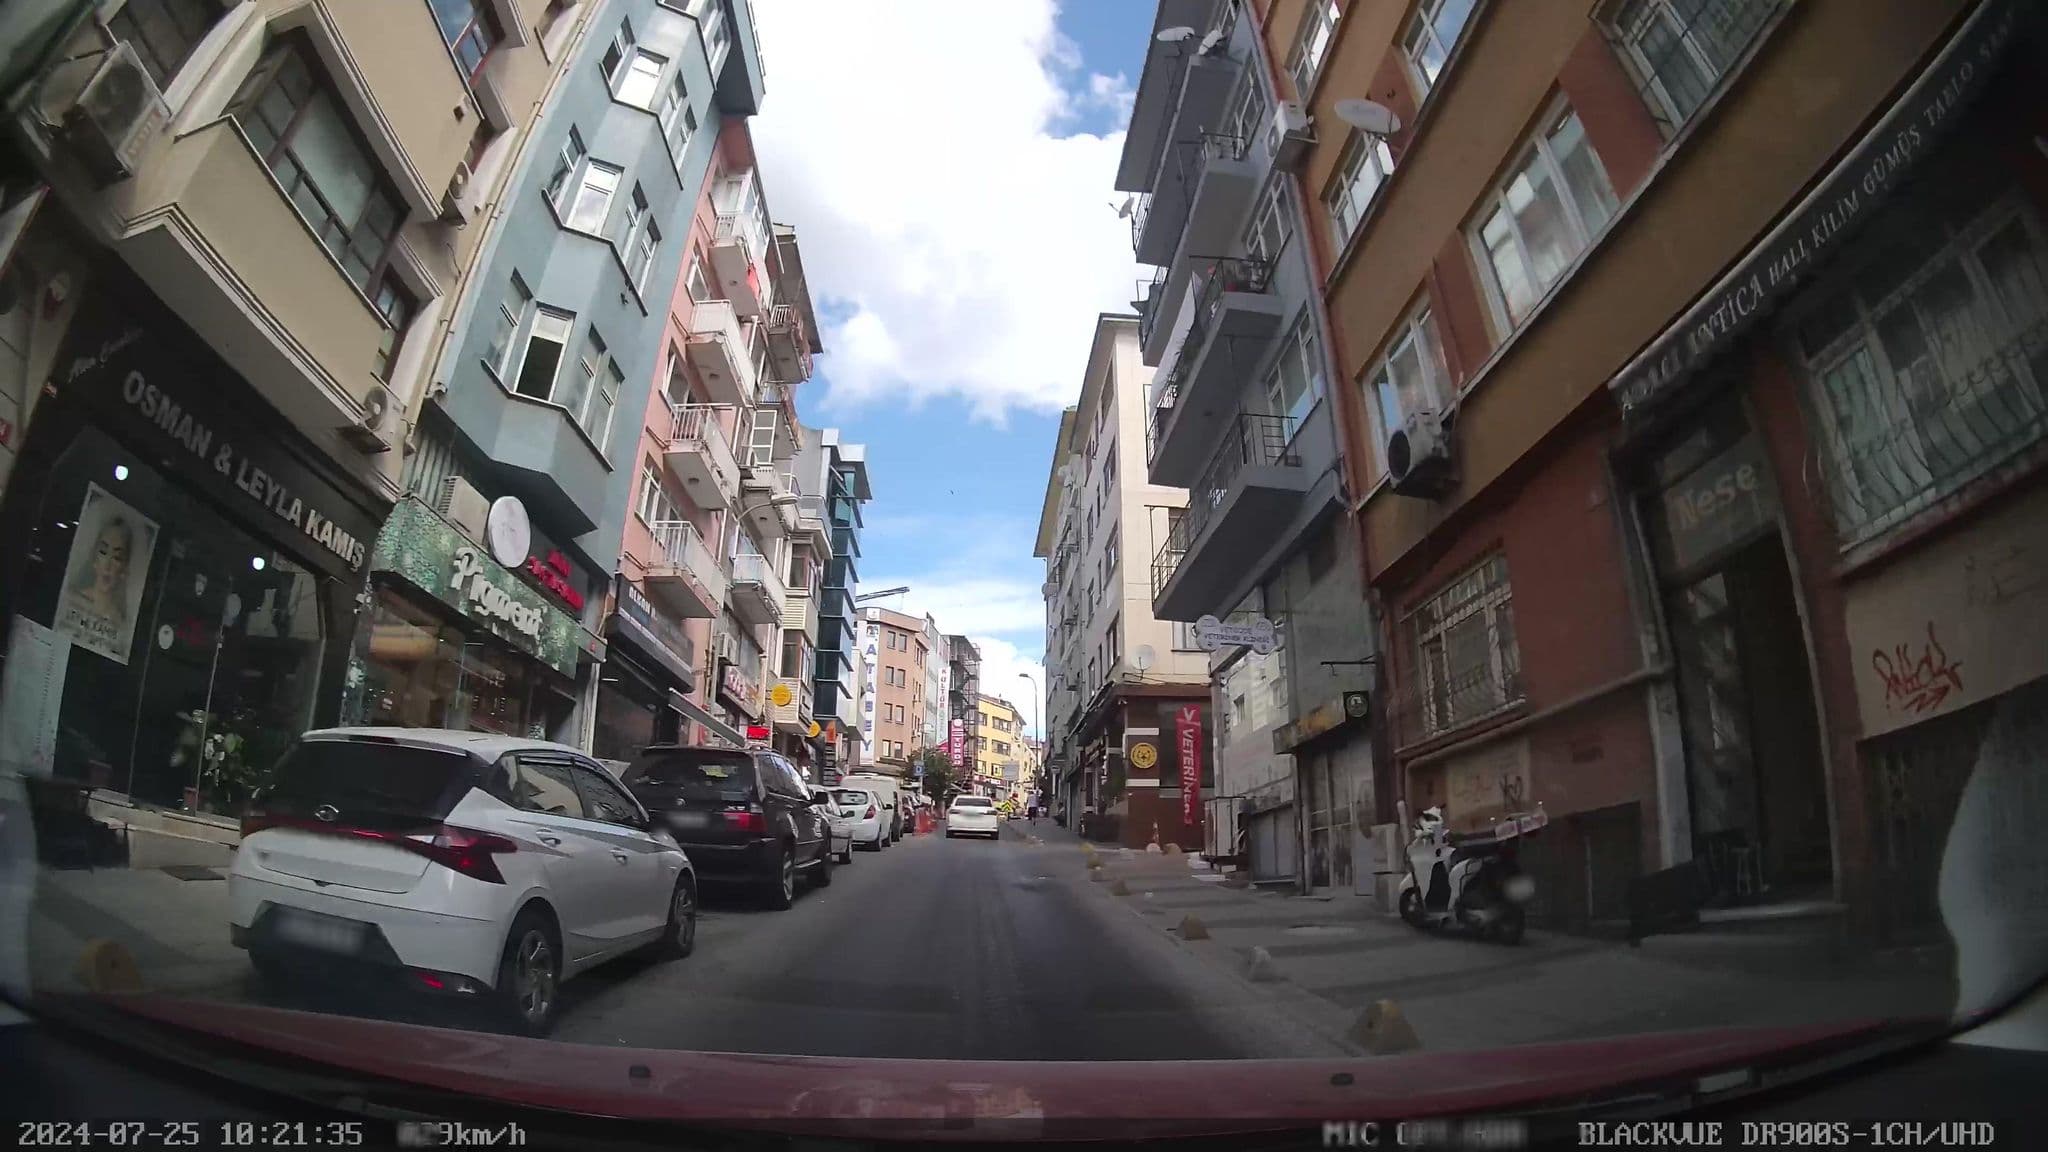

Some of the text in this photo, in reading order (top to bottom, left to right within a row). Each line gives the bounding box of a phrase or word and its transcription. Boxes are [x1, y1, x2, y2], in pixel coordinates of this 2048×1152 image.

[1769, 239, 1808, 288] HALI
[1863, 125, 1921, 196] GÜMÜŞ
[123, 370, 366, 573] OSMAN & LEYLA KAMIŞ
[863, 643, 877, 752] ATABEY
